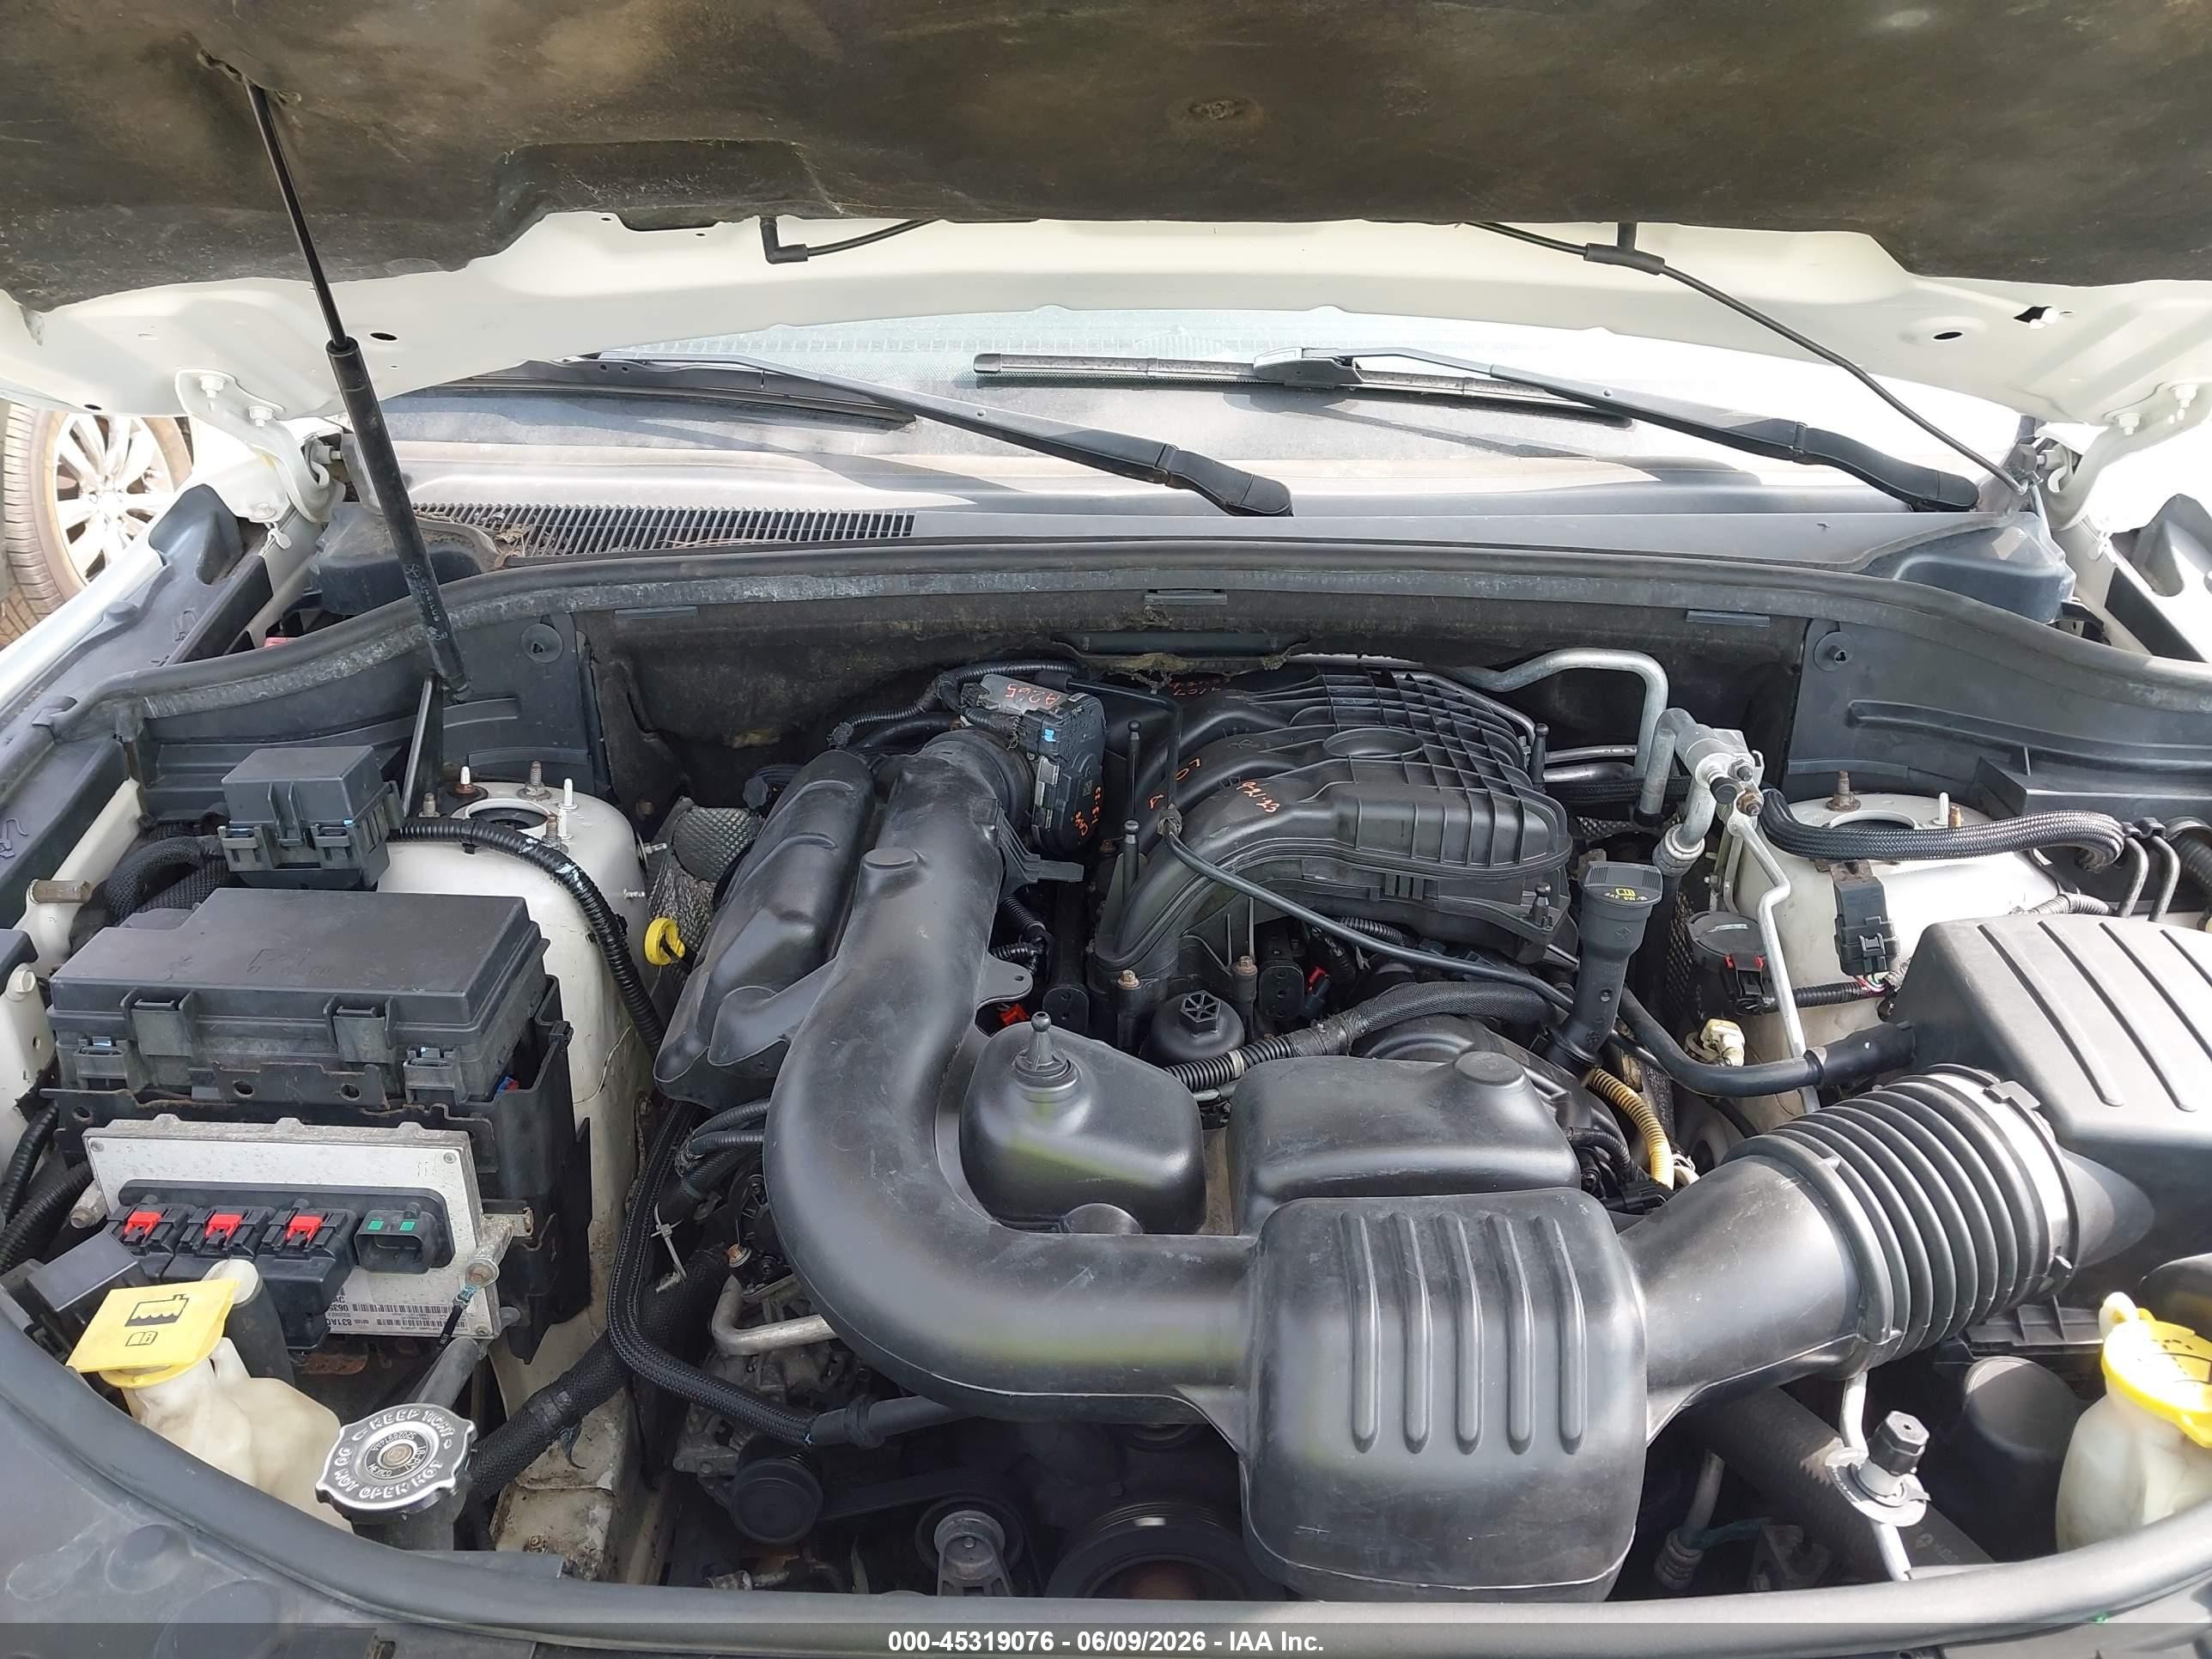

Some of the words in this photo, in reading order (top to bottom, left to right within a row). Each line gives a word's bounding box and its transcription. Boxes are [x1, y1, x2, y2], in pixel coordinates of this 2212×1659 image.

[368, 1408, 421, 1431] KEEP
[422, 1409, 455, 1437] TIGHT
[334, 1468, 360, 1492] NOT
[359, 1483, 410, 1499] OPEN
[410, 1460, 443, 1487] HOT
[368, 1462, 392, 1477] MEXICO
